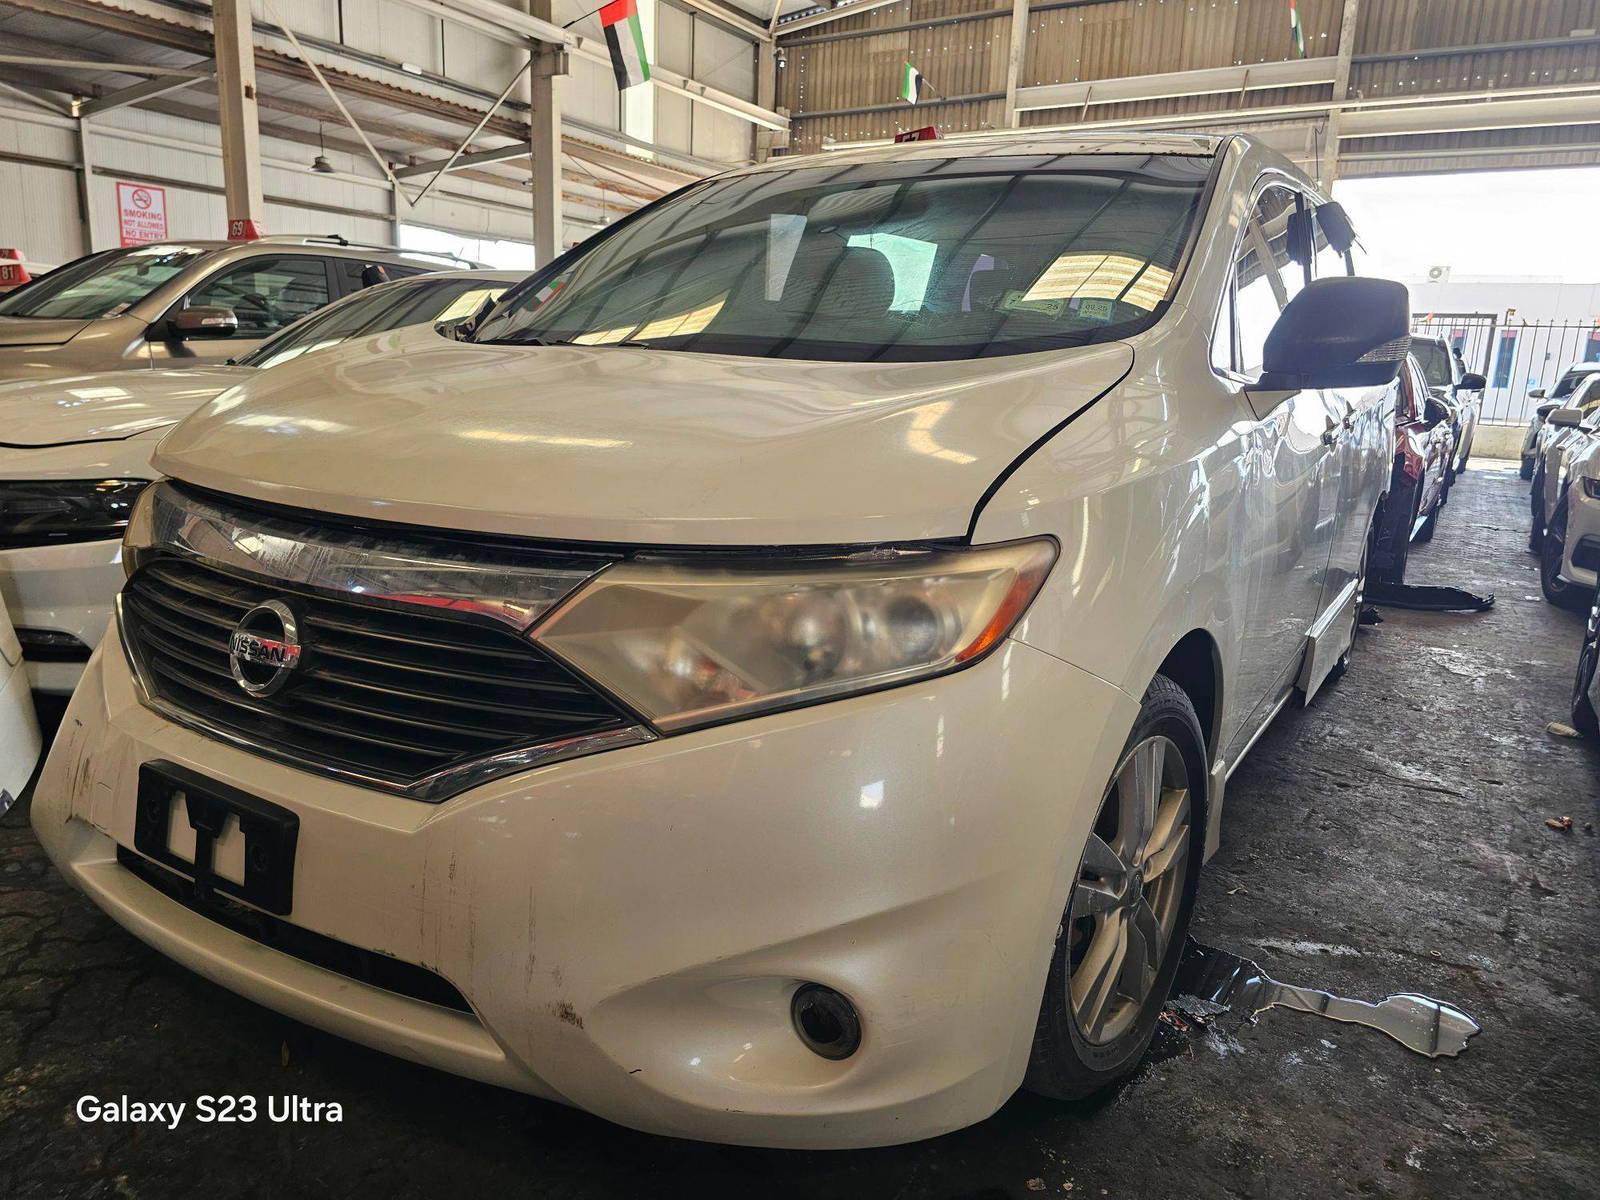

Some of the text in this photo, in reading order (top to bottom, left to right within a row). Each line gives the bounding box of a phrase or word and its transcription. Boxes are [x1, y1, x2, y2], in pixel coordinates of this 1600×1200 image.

[124, 209, 162, 220] SMOKING
[125, 229, 163, 239] NO ENTRY
[233, 221, 243, 236] 69
[2, 266, 14, 280] 81
[230, 633, 288, 664] NISSAN
